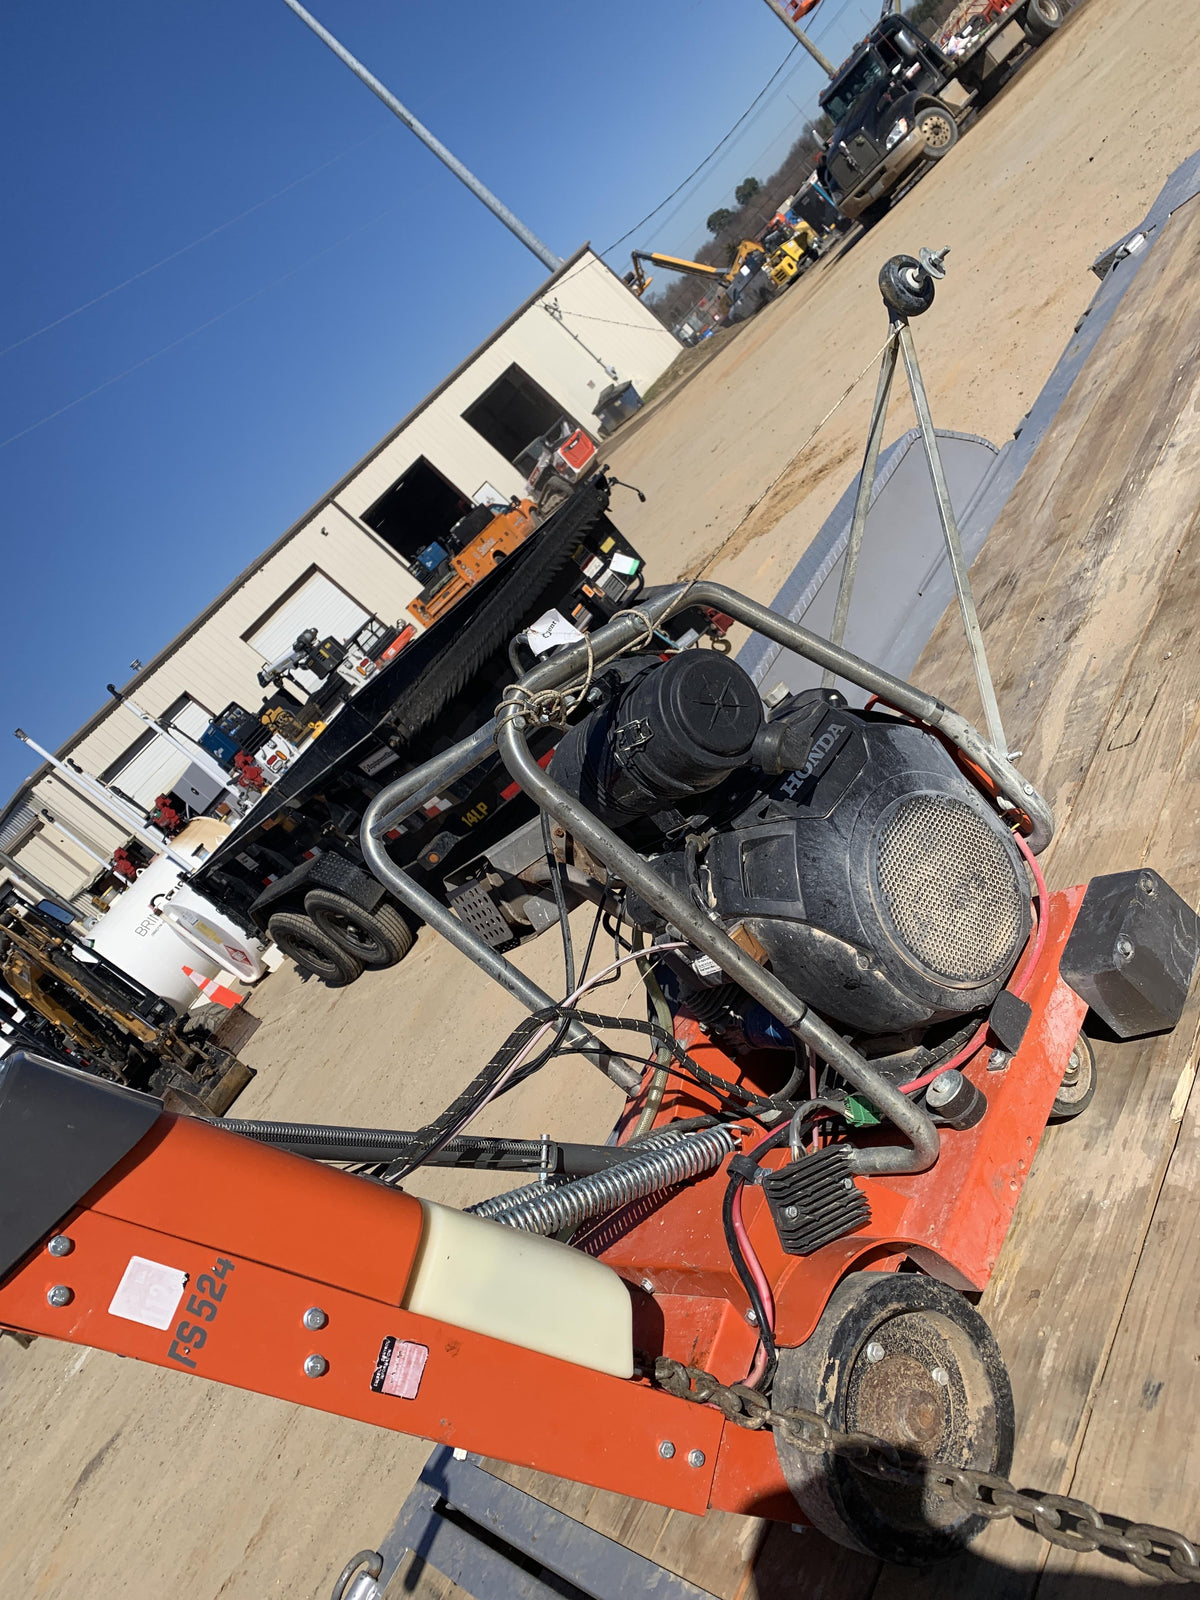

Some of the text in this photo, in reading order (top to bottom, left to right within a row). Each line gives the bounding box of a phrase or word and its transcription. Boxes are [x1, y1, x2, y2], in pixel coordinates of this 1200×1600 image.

[780, 723, 847, 798] HONDA
[461, 801, 488, 827] 14LP
[167, 1257, 235, 1369] FS 524
